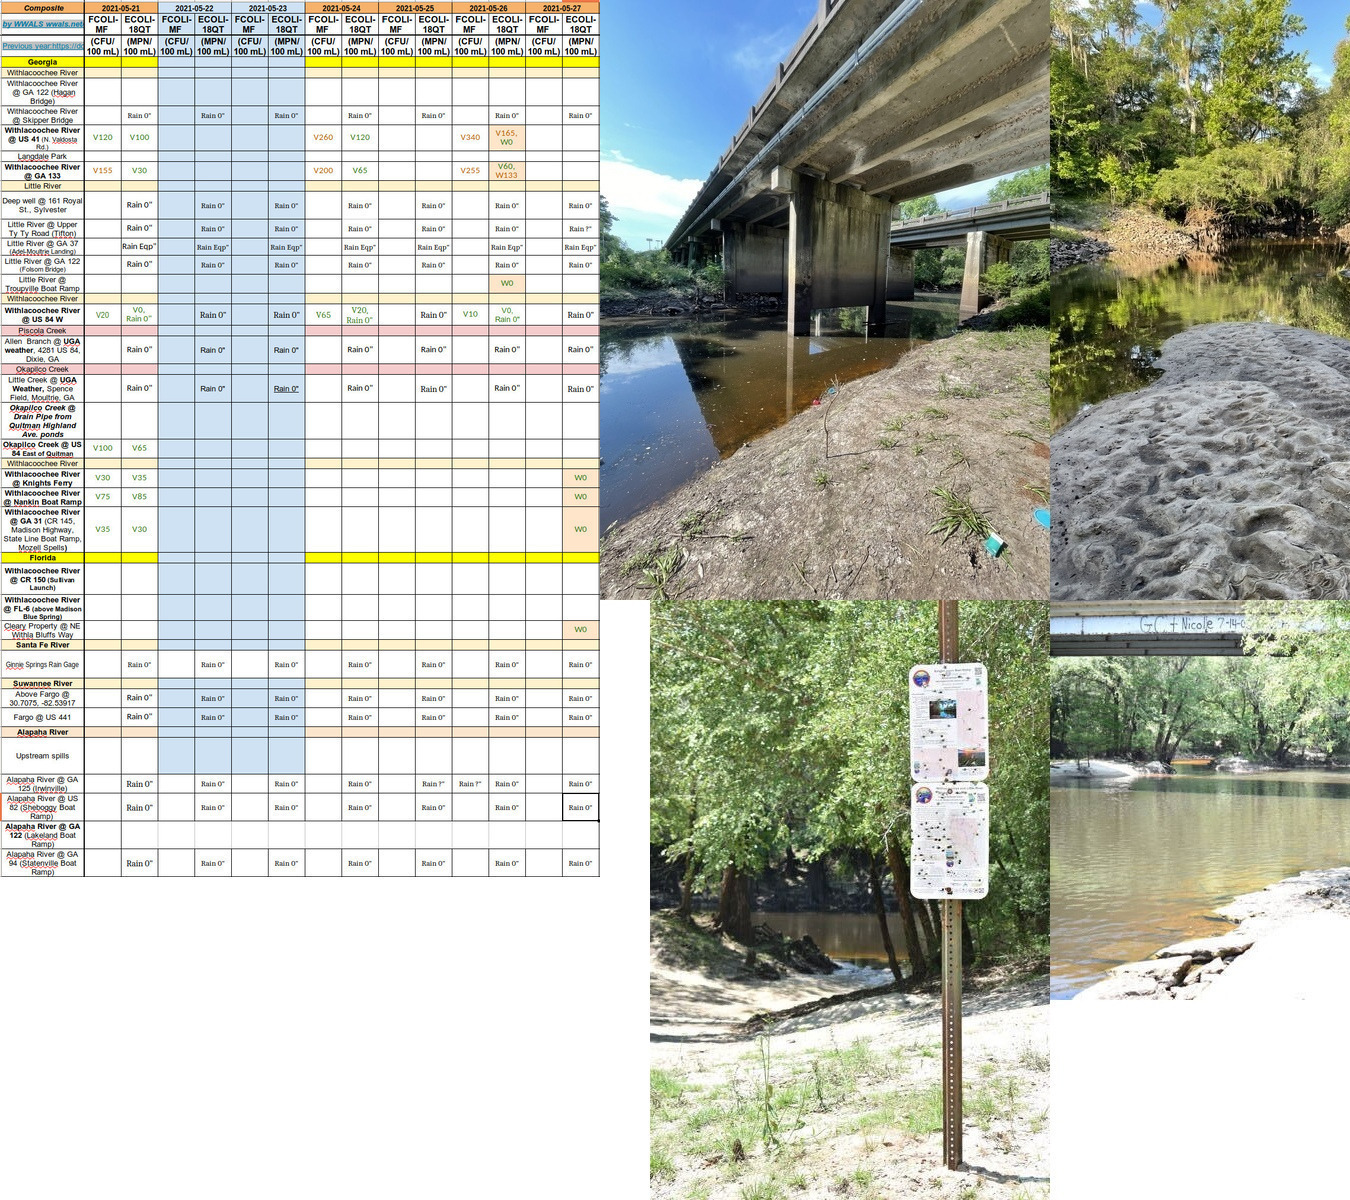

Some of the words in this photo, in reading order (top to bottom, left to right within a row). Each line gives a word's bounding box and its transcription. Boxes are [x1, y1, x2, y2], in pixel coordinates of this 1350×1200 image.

[102, 4, 140, 12] 2021-05-21
[175, 4, 214, 12] 2021-05-22
[249, 4, 287, 12] 2021-05-23
[322, 4, 361, 12] 2021-05-24
[396, 4, 434, 12] 2021-05-25
[469, 4, 508, 12] 2021-05-26
[543, 4, 582, 12] 2021-05-27
[103, 48, 119, 56] mL)
[140, 48, 156, 56] mL)
[93, 133, 113, 141] V120
[130, 133, 150, 141] V100
[314, 133, 334, 141] V260
[350, 133, 370, 141] V120
[461, 133, 481, 141] V340
[17, 152, 49, 160] Langdale
[50, 152, 67, 160] Park
[24, 182, 41, 190] Little
[42, 182, 62, 190] River
[29, 553, 56, 562] Florida
[16, 641, 37, 649] Santa
[38, 641, 48, 649] Fe
[51, 641, 70, 649] River
[13, 680, 51, 688] Suwannee
[52, 680, 72, 688] River
[17, 728, 47, 736] Alapaha
[49, 728, 69, 736] River
[15, 752, 50, 760] Upstream
[51, 752, 70, 760] spills
